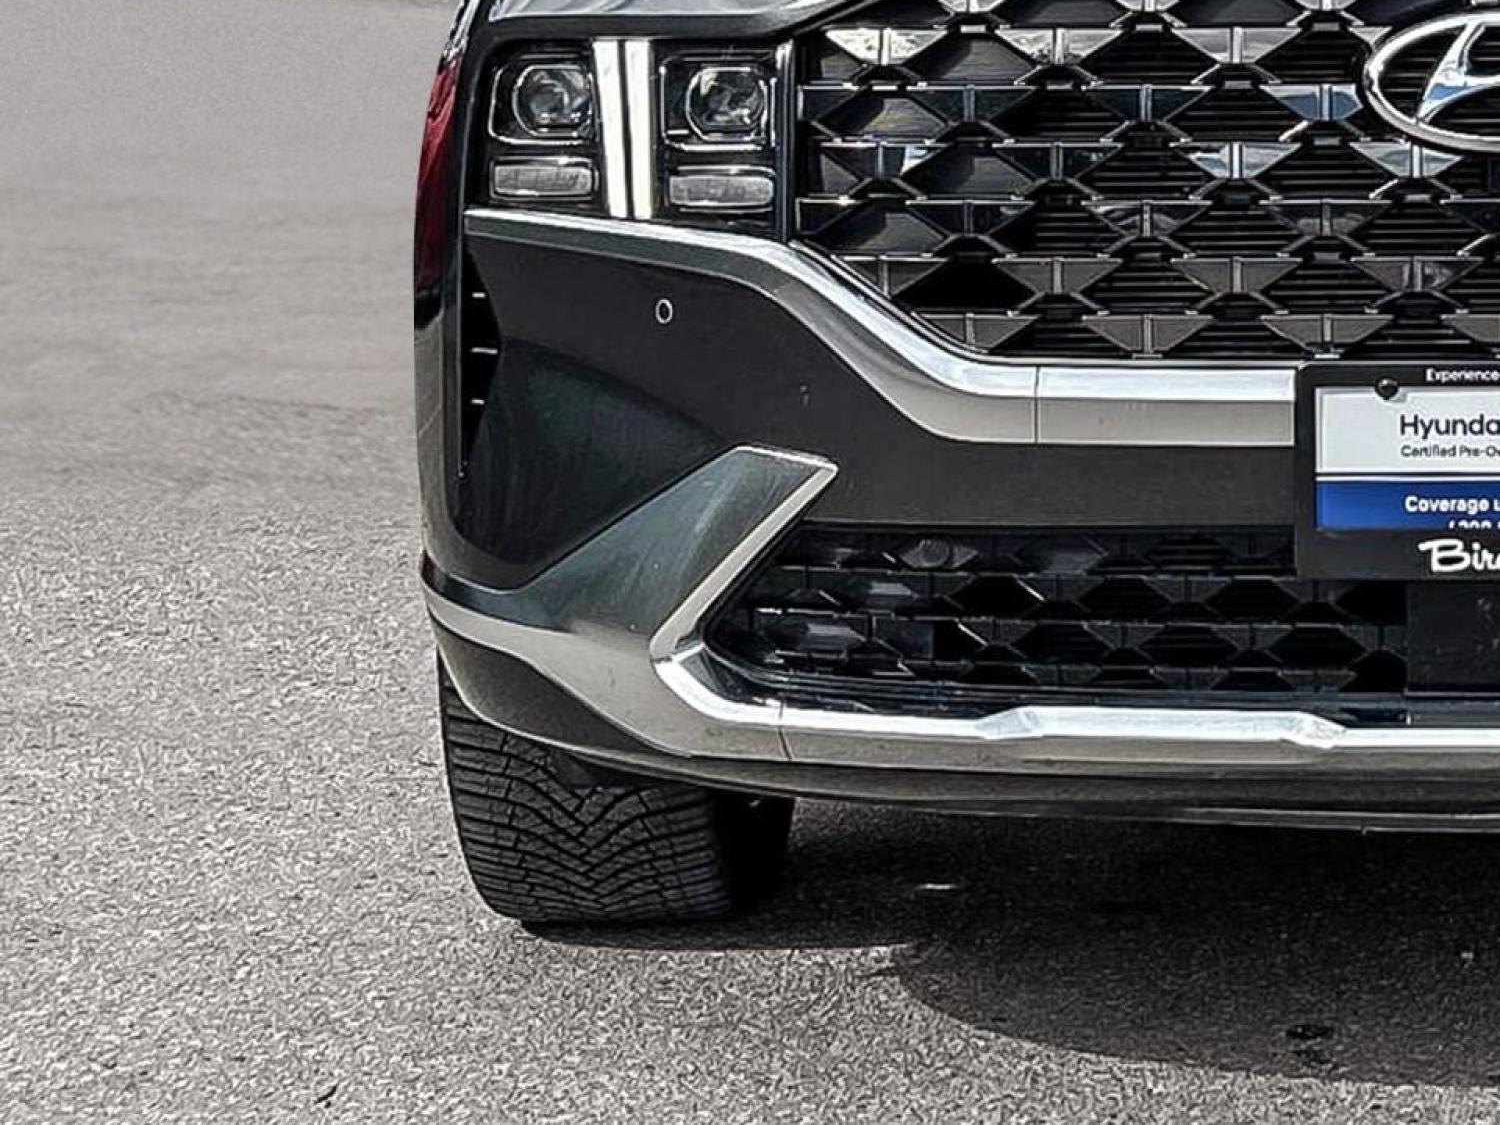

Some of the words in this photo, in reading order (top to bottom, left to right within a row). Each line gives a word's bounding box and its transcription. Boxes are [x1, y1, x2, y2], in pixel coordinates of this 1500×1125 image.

[1426, 368, 1500, 382] Experience
[1401, 444, 1457, 457] Certified
[1404, 495, 1490, 515] Coverage
